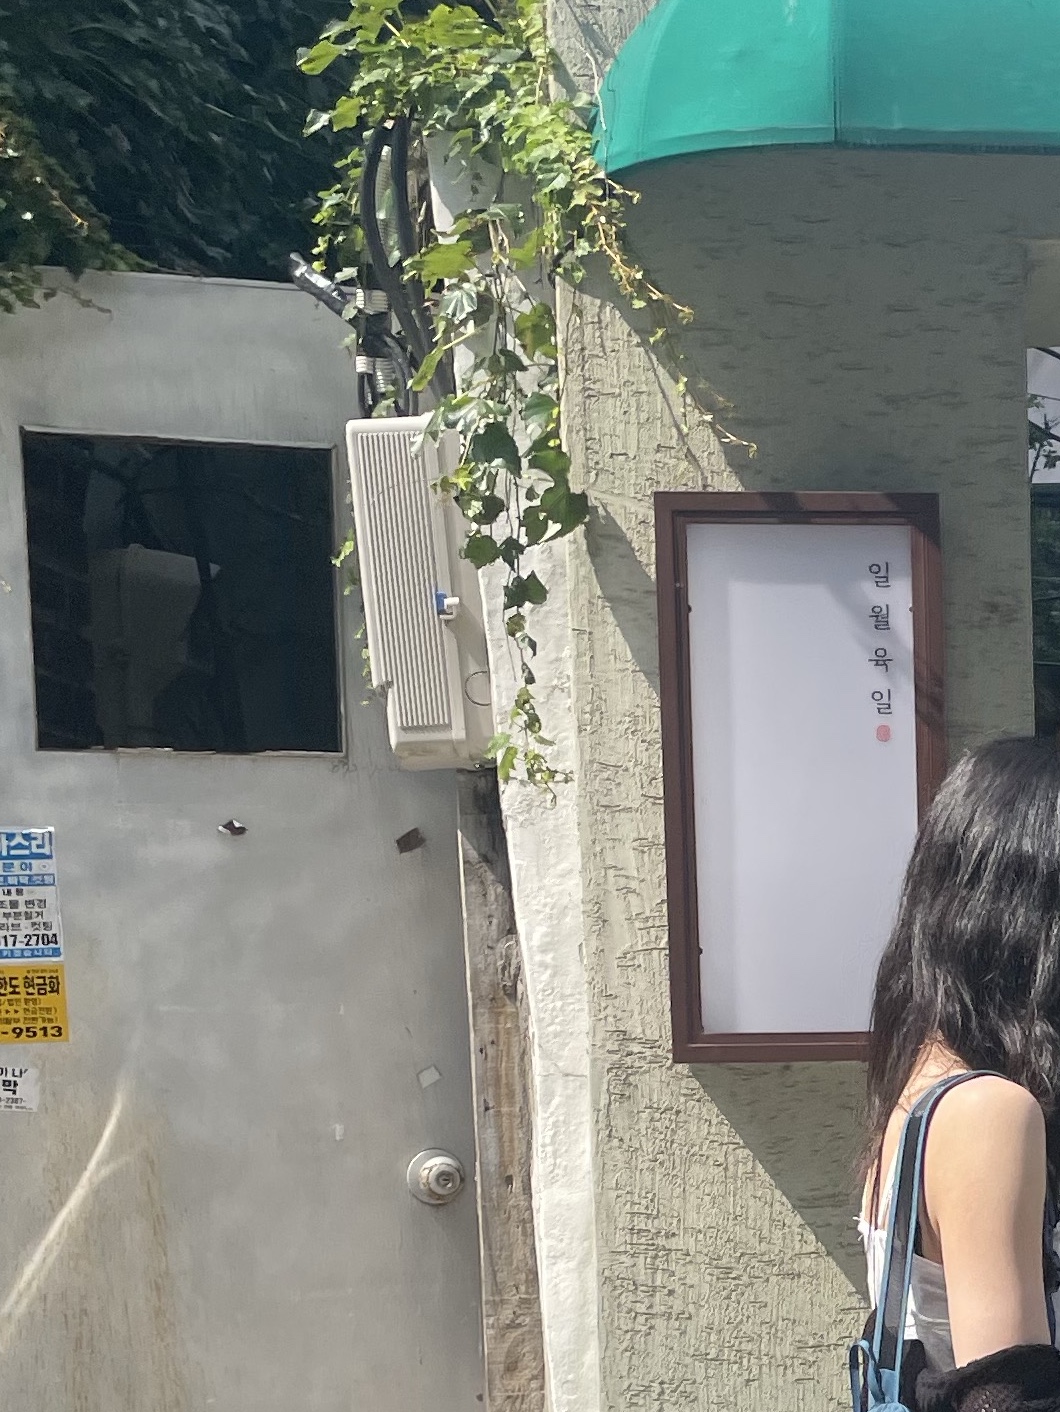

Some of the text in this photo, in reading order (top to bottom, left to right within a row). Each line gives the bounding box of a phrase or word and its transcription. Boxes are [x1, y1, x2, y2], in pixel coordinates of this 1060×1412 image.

[0, 933, 58, 947] 17-2704
[23, 975, 60, 996] 현금화
[1, 1025, 63, 1039] -9513
